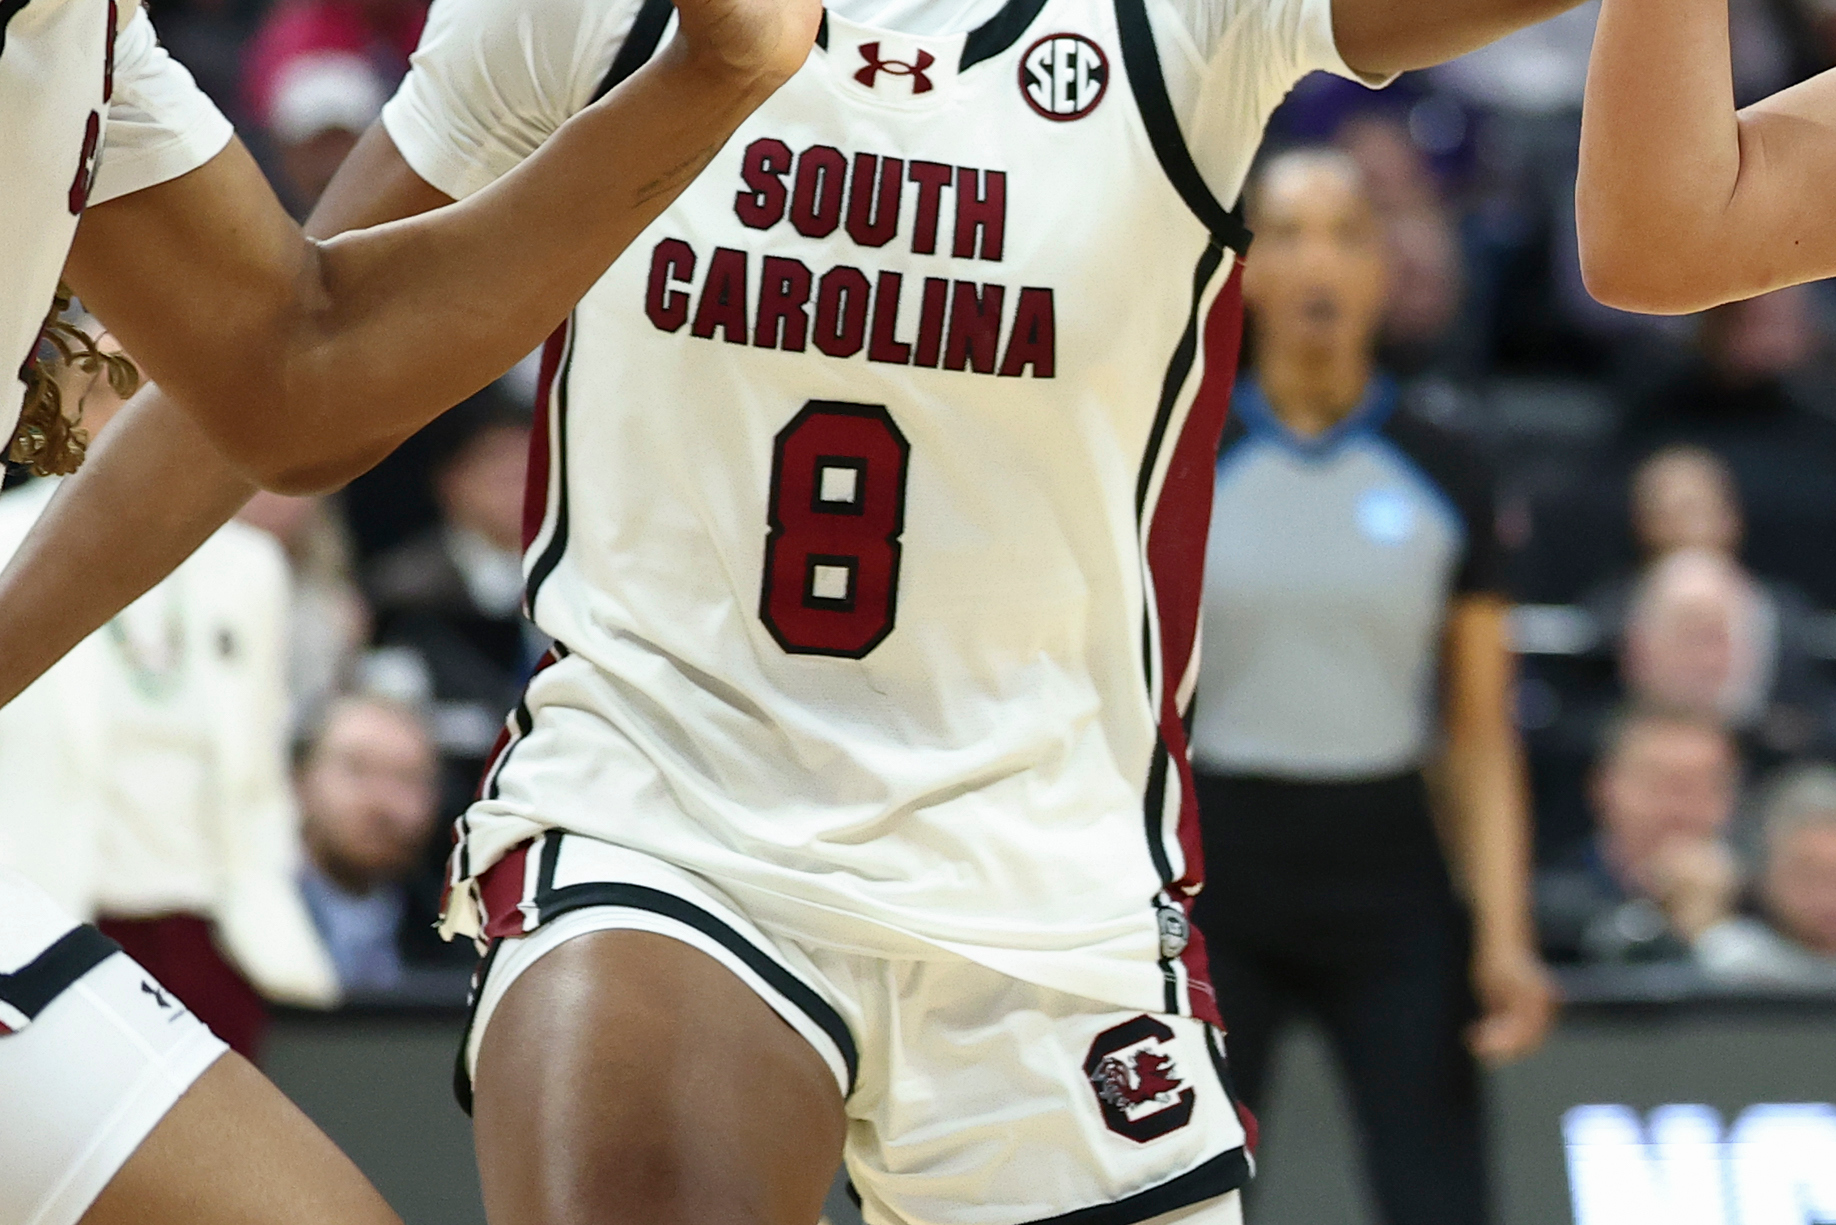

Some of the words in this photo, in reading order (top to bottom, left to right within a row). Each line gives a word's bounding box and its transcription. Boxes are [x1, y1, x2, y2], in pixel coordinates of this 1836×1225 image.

[1022, 36, 1105, 117] SEC
[734, 136, 1008, 263] SOUTH
[645, 237, 1057, 379] CAROLINA
[759, 398, 911, 660] 8
